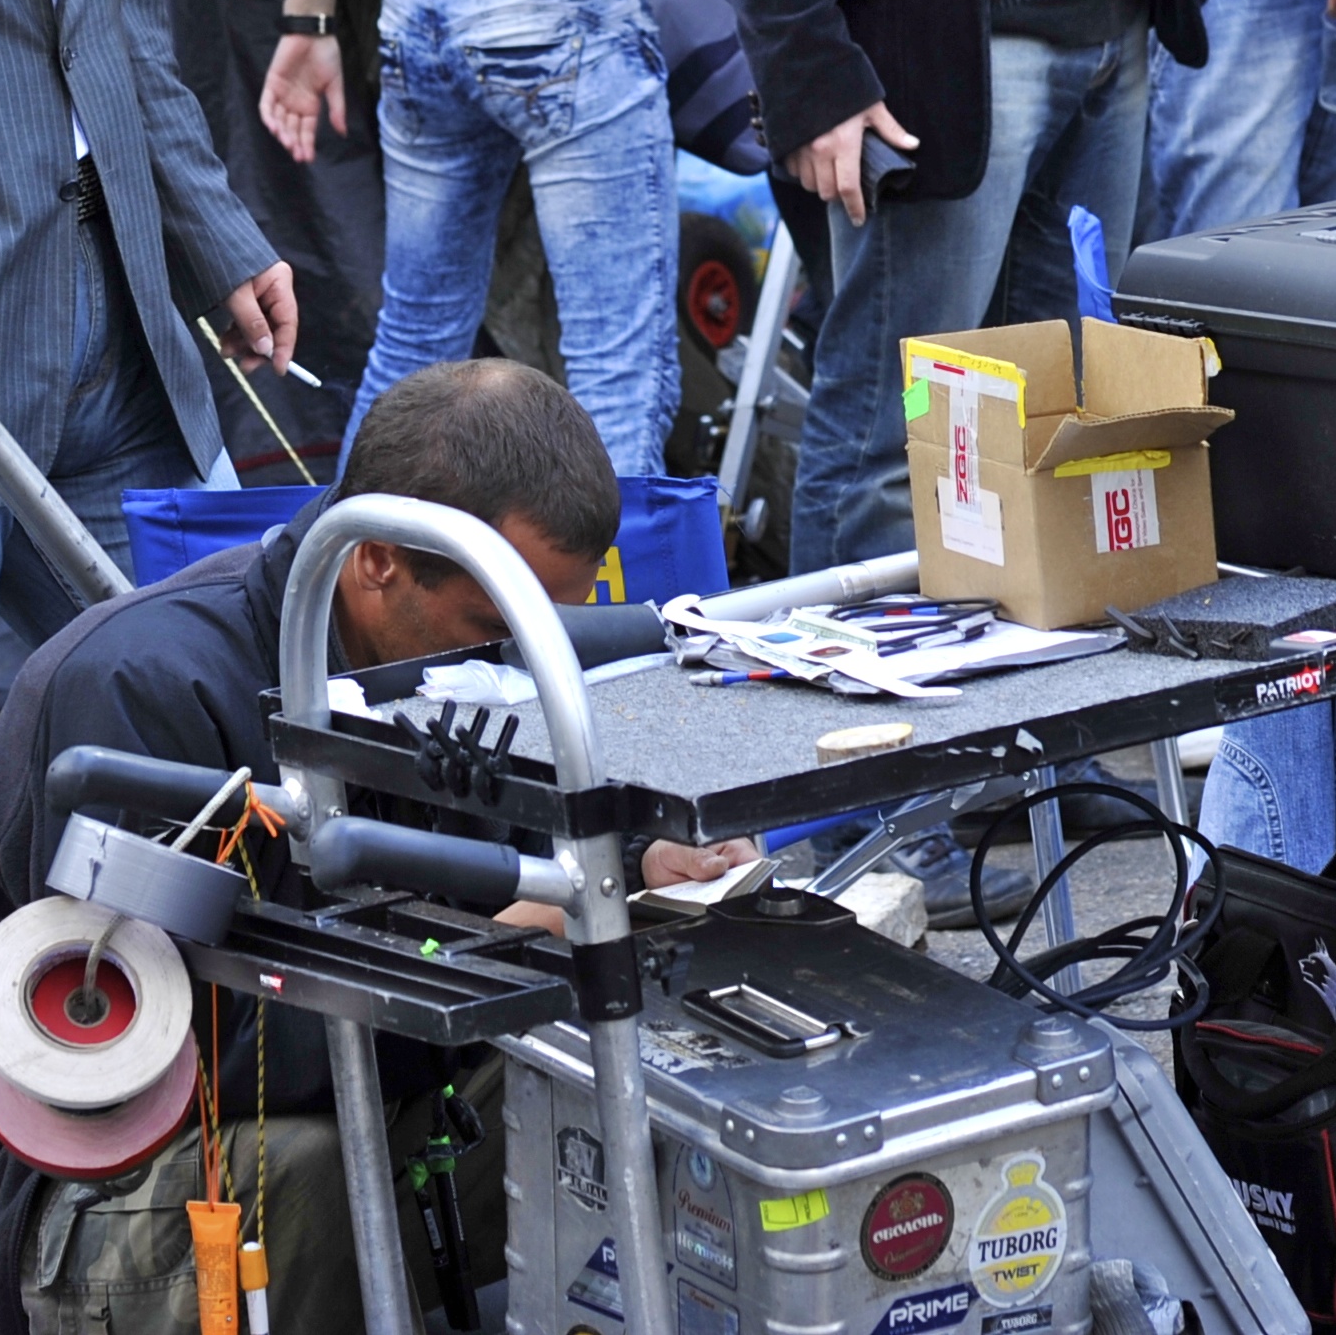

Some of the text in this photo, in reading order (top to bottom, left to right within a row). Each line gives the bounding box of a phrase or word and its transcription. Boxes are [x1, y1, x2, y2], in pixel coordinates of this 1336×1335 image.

[955, 425, 969, 504] ZGC
[1256, 670, 1322, 699] PATRIOT
[678, 1188, 732, 1234] Premium
[1232, 1178, 1294, 1221] USKY
[978, 1227, 1058, 1262] TUBORG
[992, 1262, 1041, 1283] TWIST
[889, 1291, 969, 1328] PRIME
[1001, 1313, 1038, 1329] TUBORG
